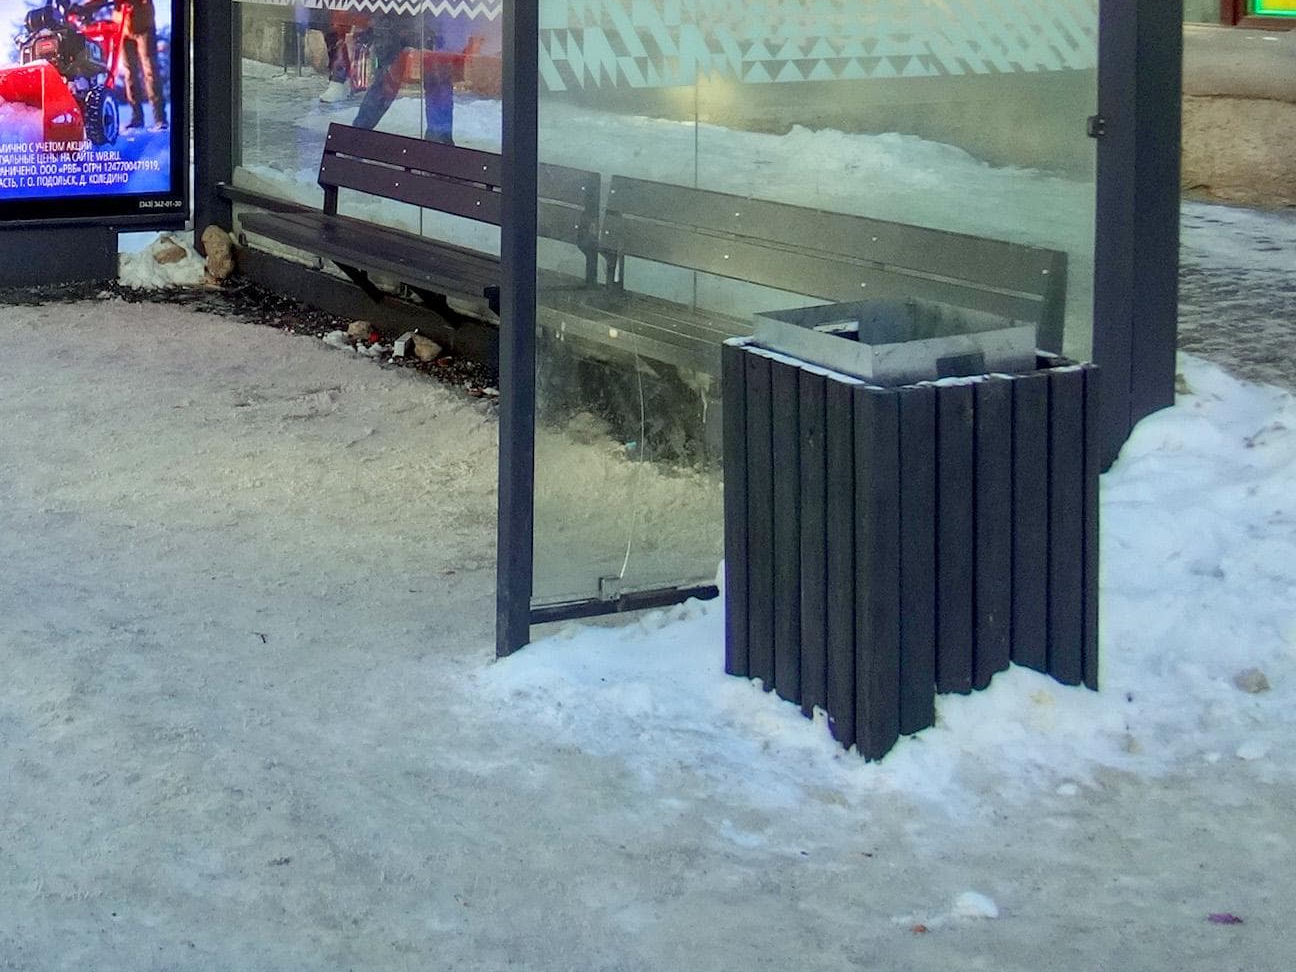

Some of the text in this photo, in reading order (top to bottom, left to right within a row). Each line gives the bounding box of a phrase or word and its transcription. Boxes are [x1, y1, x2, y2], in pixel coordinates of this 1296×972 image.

[66, 138, 92, 151] АКЦИЙ
[37, 153, 58, 164] ЦЕНЫ
[60, 152, 71, 163] НА
[72, 149, 94, 162] САЙТЕ
[39, 164, 57, 175] ООО
[82, 162, 102, 173] ОГРН
[89, 172, 129, 185] КОЛЕДИНО
